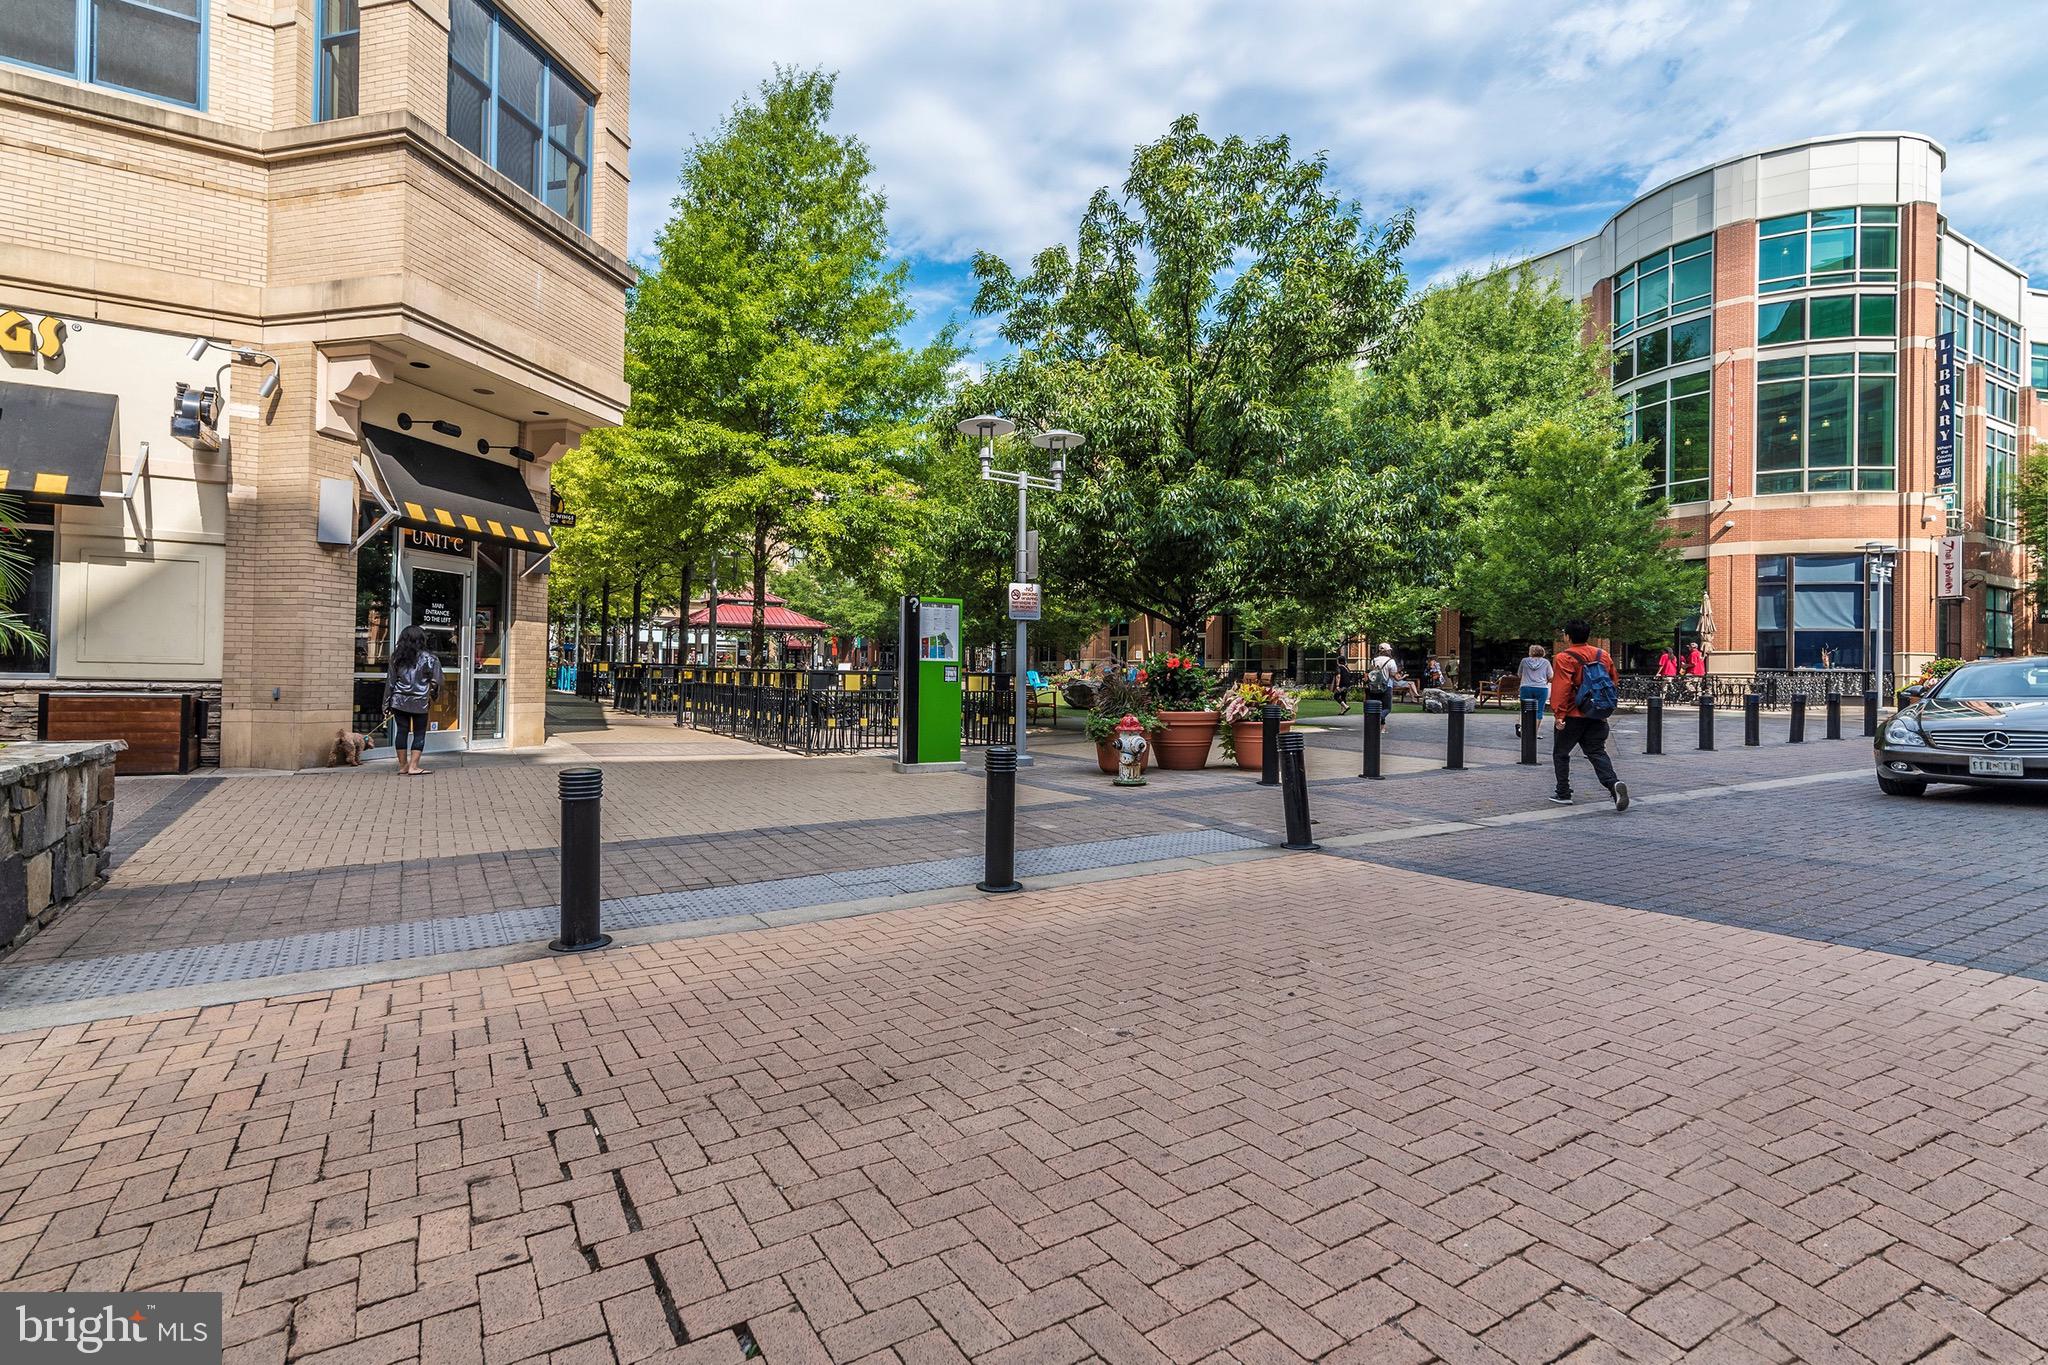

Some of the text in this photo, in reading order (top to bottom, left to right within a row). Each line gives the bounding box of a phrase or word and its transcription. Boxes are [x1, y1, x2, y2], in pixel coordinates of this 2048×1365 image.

[1939, 338, 1951, 442] LIBRARY
[412, 529, 464, 552] UNIT C
[425, 609, 450, 617] ENTRANCE
